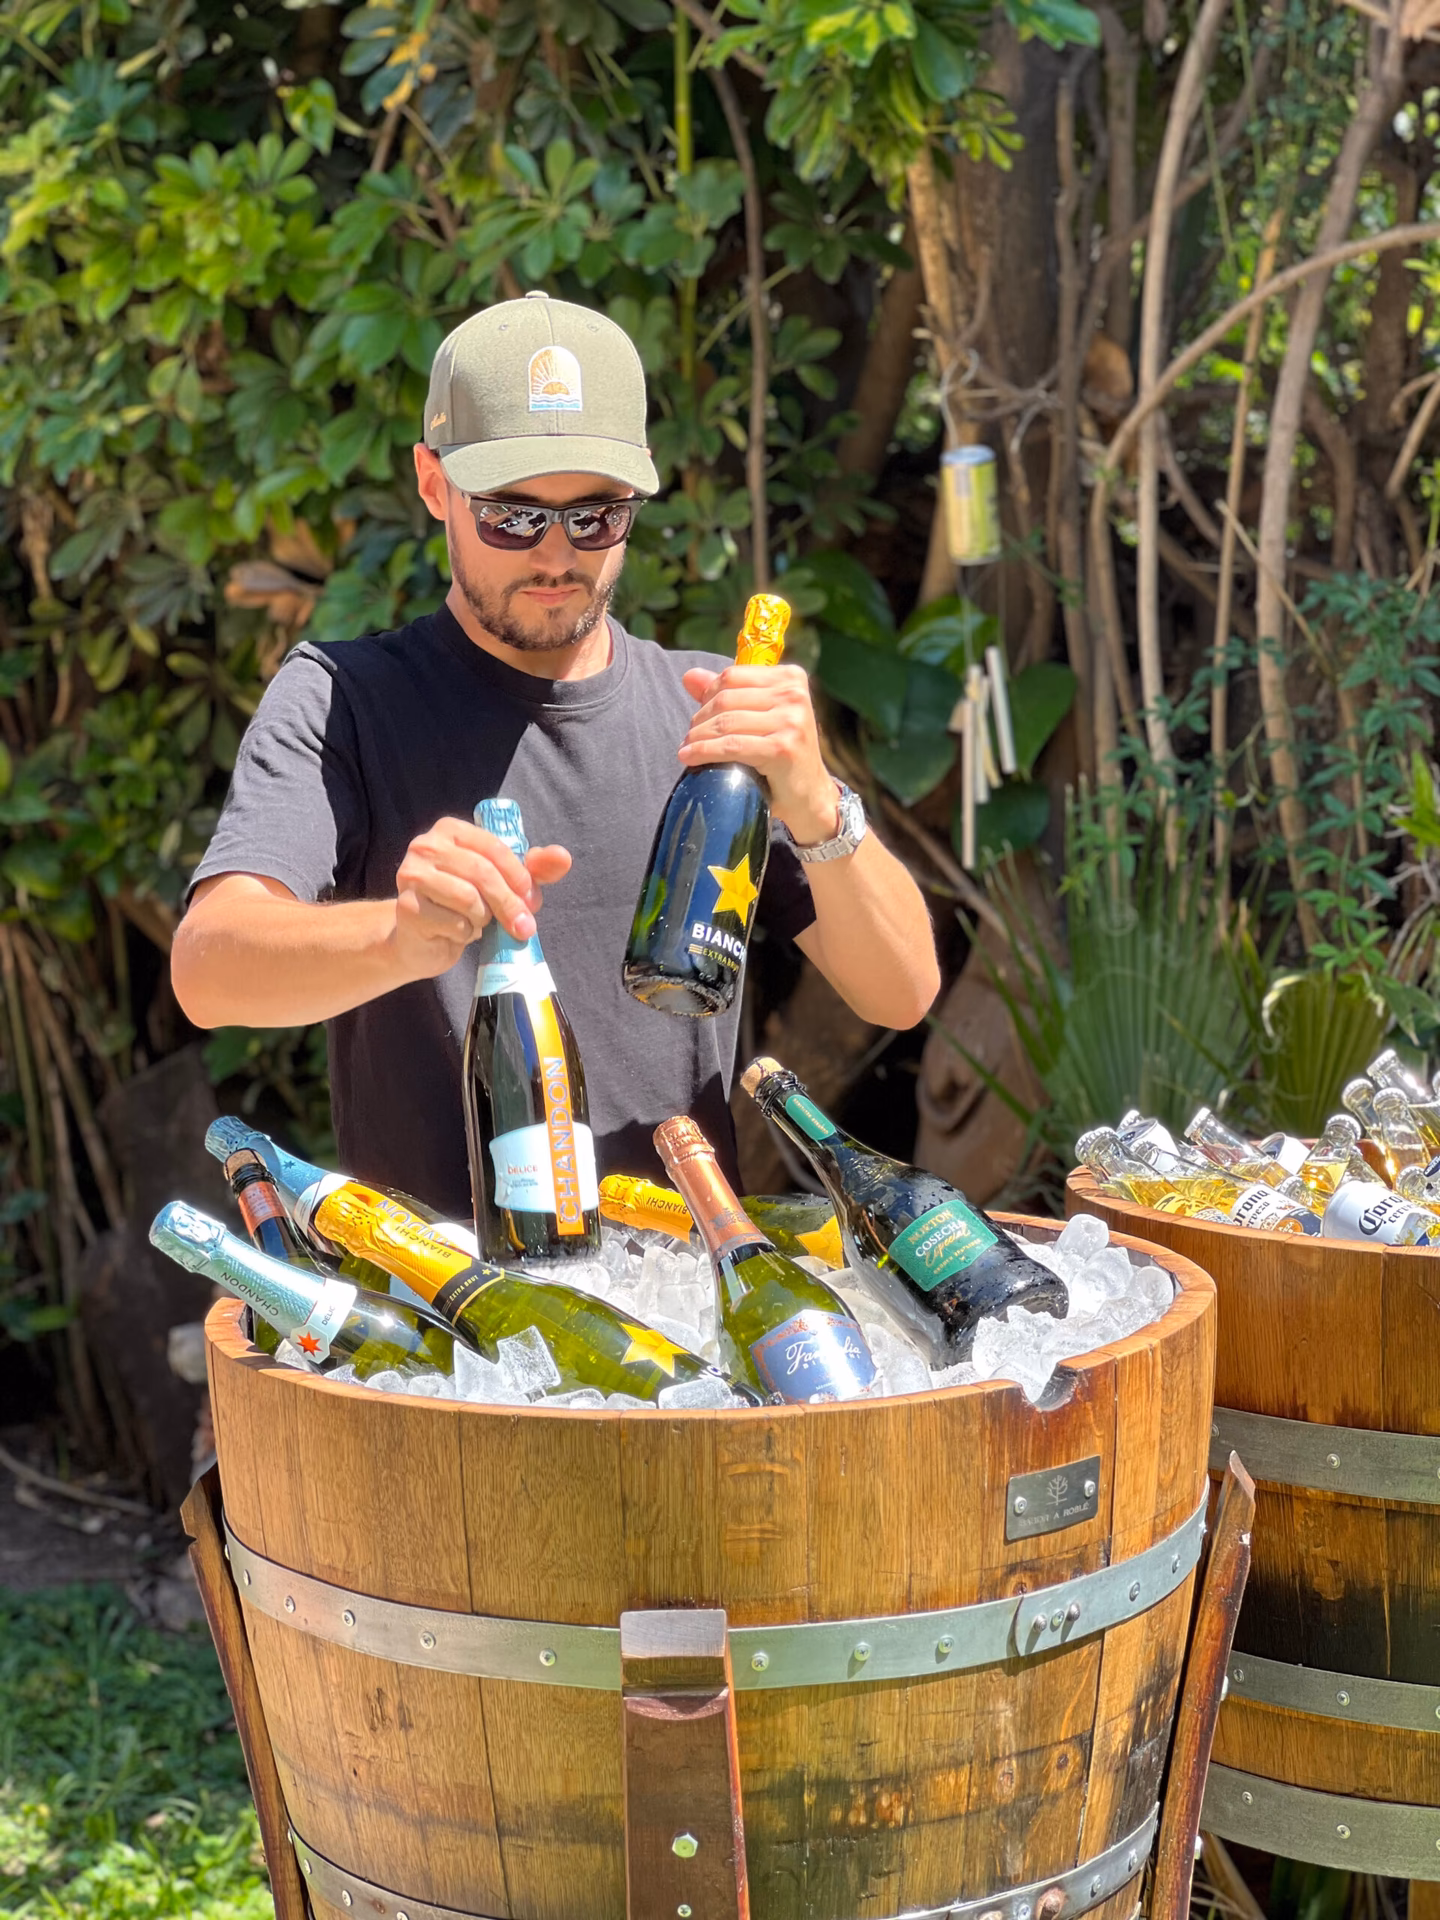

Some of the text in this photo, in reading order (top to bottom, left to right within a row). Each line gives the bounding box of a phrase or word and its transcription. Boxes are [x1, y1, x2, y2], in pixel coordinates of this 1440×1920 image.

[544, 1057, 580, 1223] CHANDON
[646, 1197, 688, 1214] BIANCHI
[395, 1226, 451, 1258] BIANCHI
[221, 1272, 279, 1316] CHANDON
[449, 1275, 478, 1301] EXTRA BRUT
